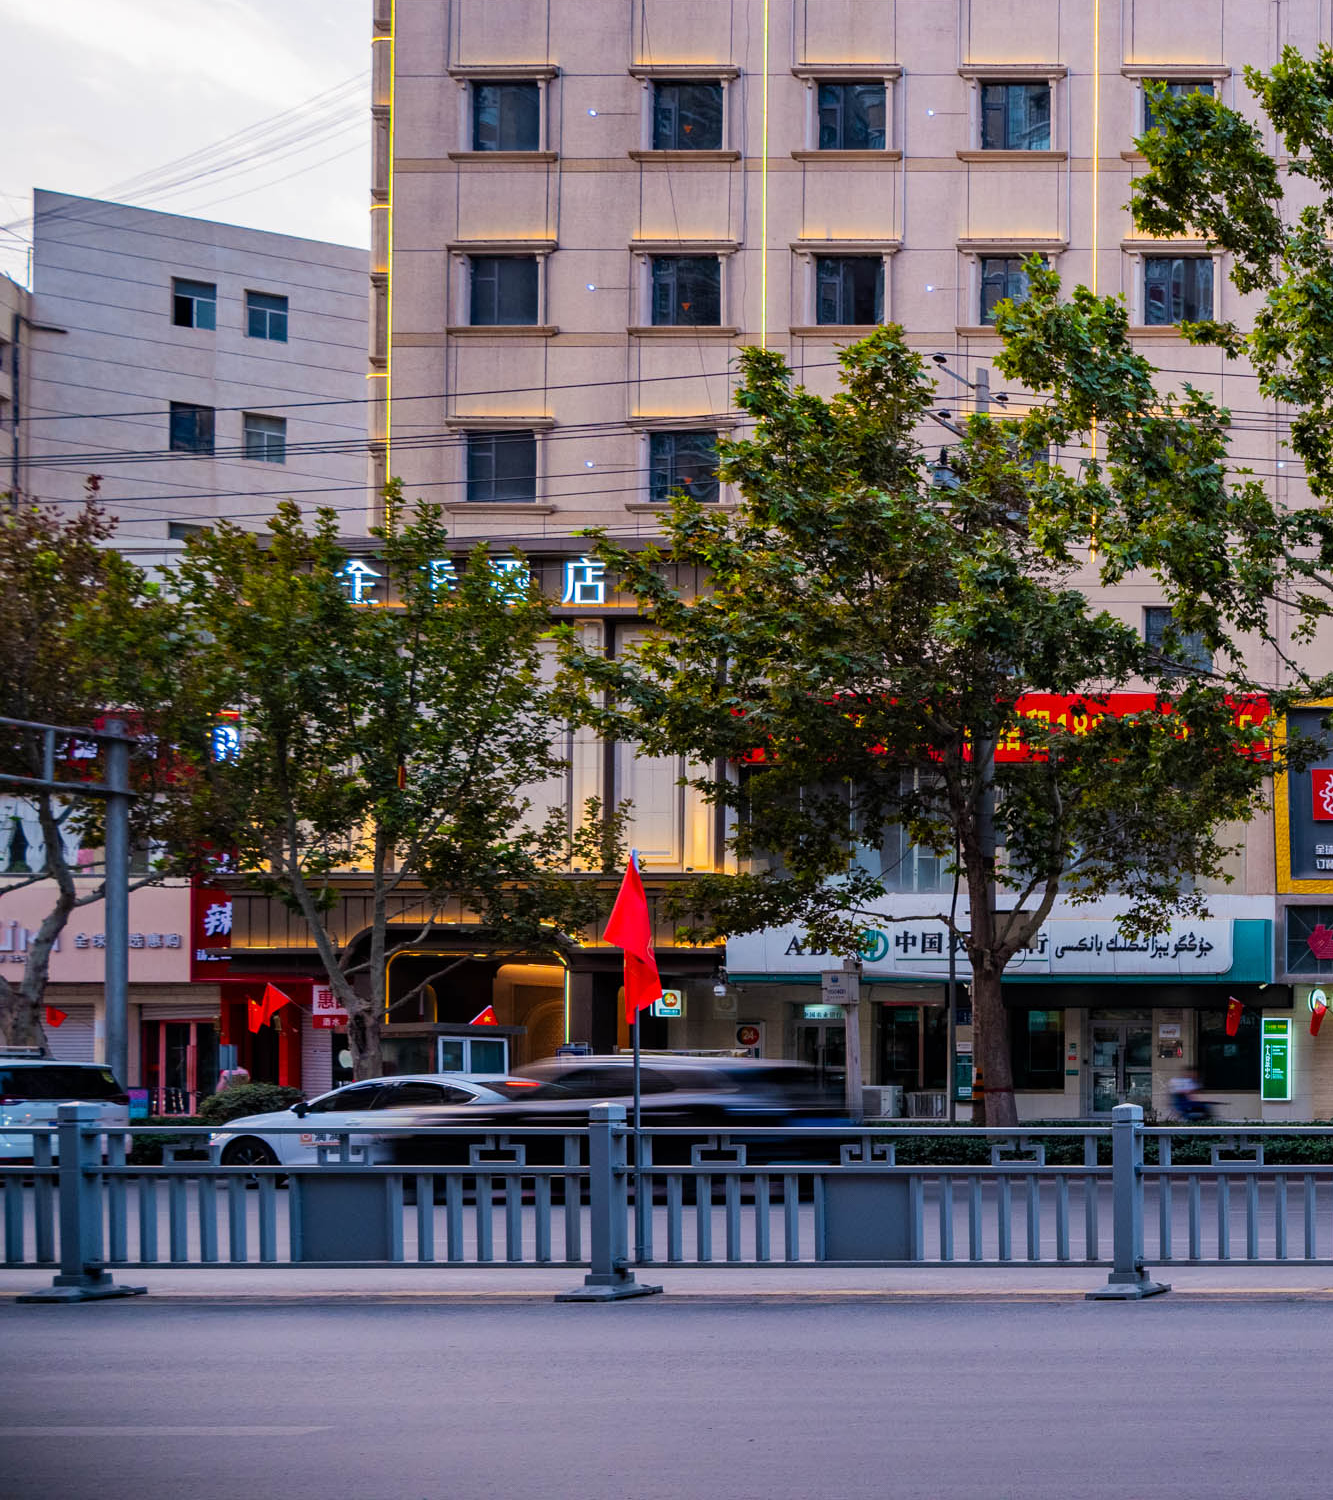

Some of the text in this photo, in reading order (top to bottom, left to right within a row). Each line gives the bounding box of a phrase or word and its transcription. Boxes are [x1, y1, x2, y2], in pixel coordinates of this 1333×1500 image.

[74, 932, 182, 950] 全球选惠购
